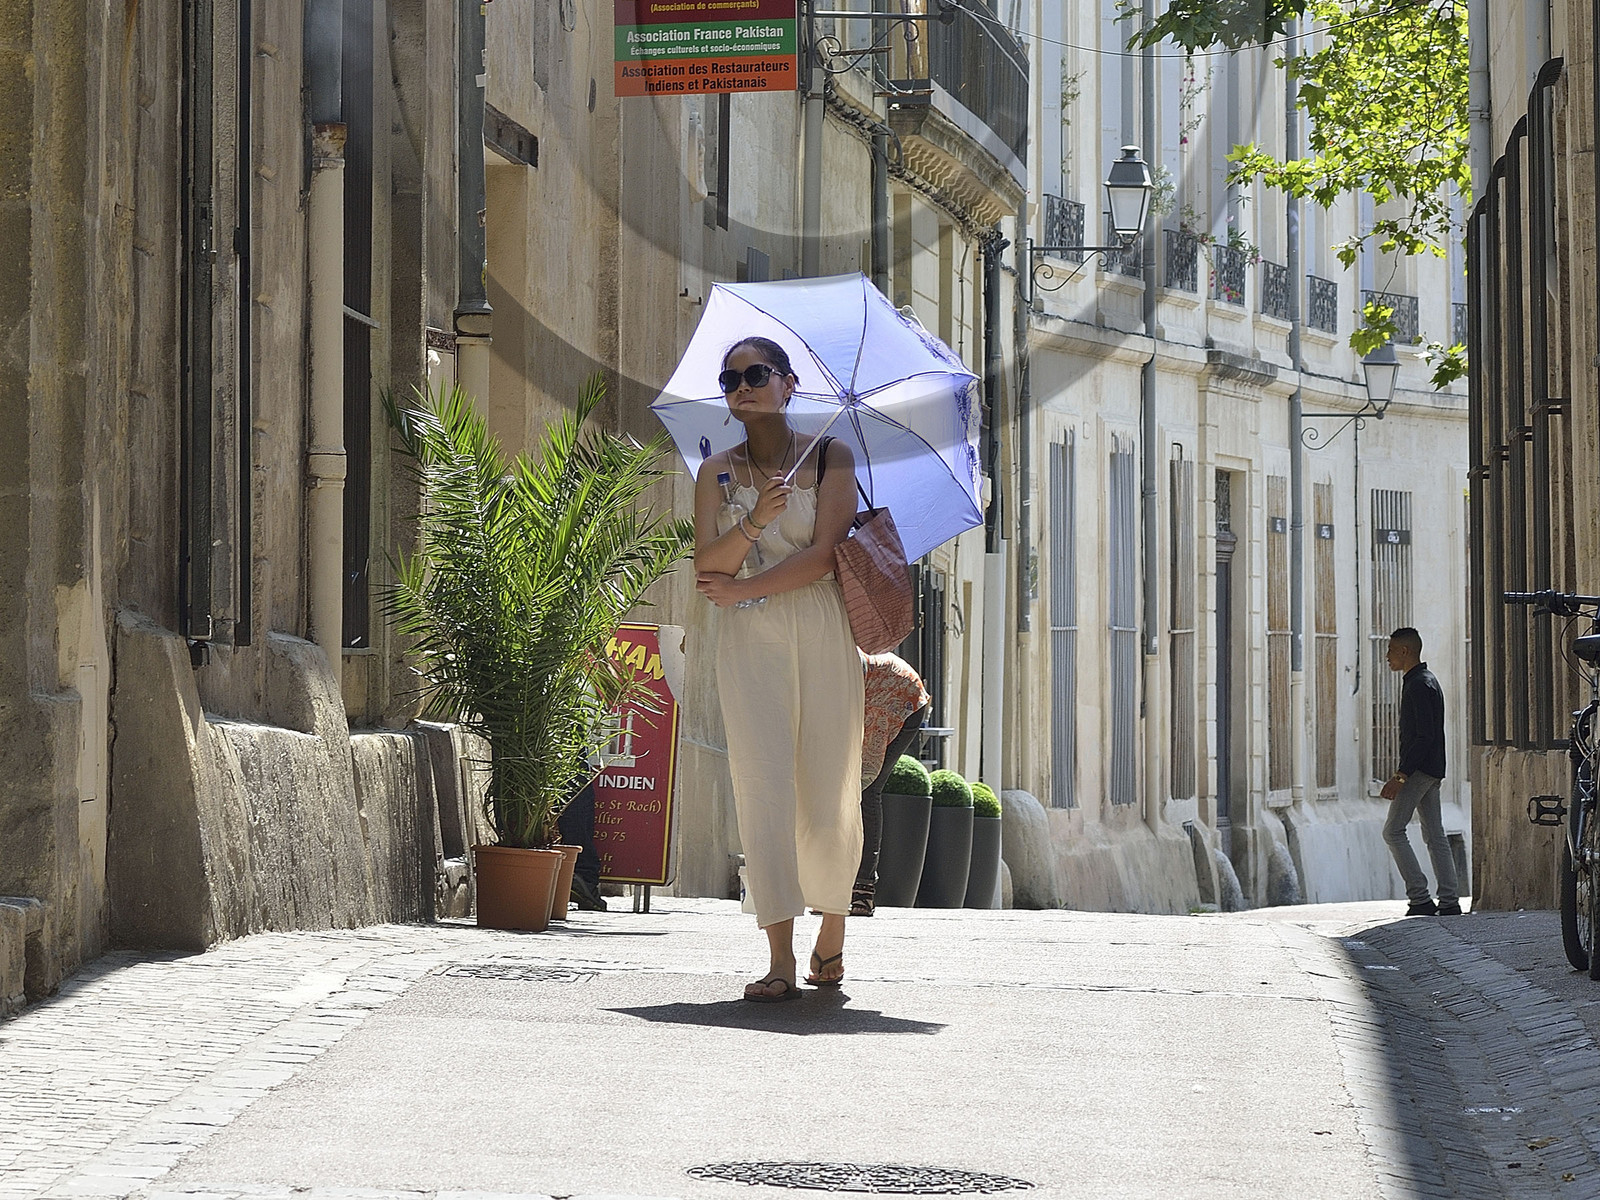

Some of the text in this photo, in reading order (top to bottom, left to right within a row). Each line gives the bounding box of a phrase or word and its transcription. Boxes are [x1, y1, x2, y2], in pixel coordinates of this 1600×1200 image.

[650, 0, 760, 13] (Association de commerçants)
[626, 26, 784, 43] Association France Pakistan
[630, 42, 781, 56] Échanges culturels et socio-économiques
[622, 61, 790, 77] Association des Restaurateurs
[644, 76, 767, 91] Indiens et Pakistanais
[598, 774, 655, 791] INDIEN
[609, 800, 622, 810] St
[626, 800, 662, 815] Roch)
[612, 831, 626, 842] 75
